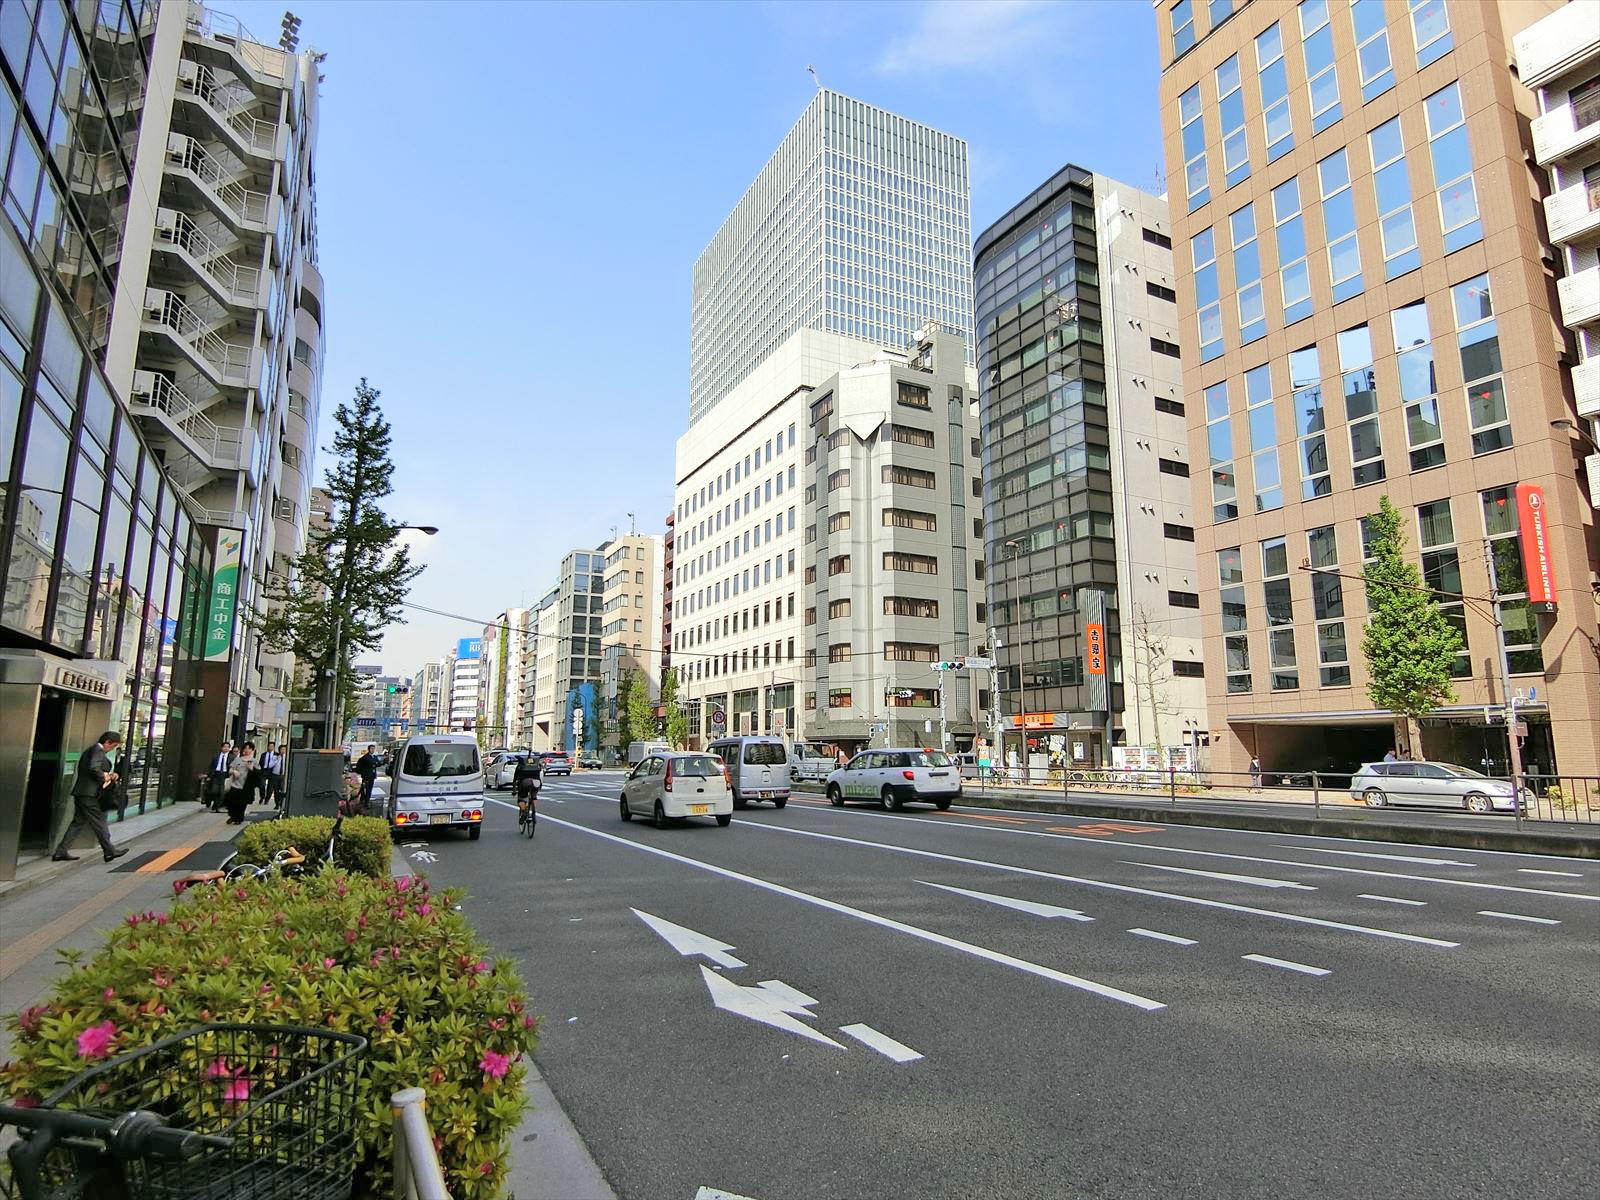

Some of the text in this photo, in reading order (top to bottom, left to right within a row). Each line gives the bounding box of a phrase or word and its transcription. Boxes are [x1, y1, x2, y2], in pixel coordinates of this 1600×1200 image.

[1533, 511, 1552, 600] TURKISH AIRLINES
[212, 582, 232, 640] 商工中金
[845, 784, 878, 796] mizkan
